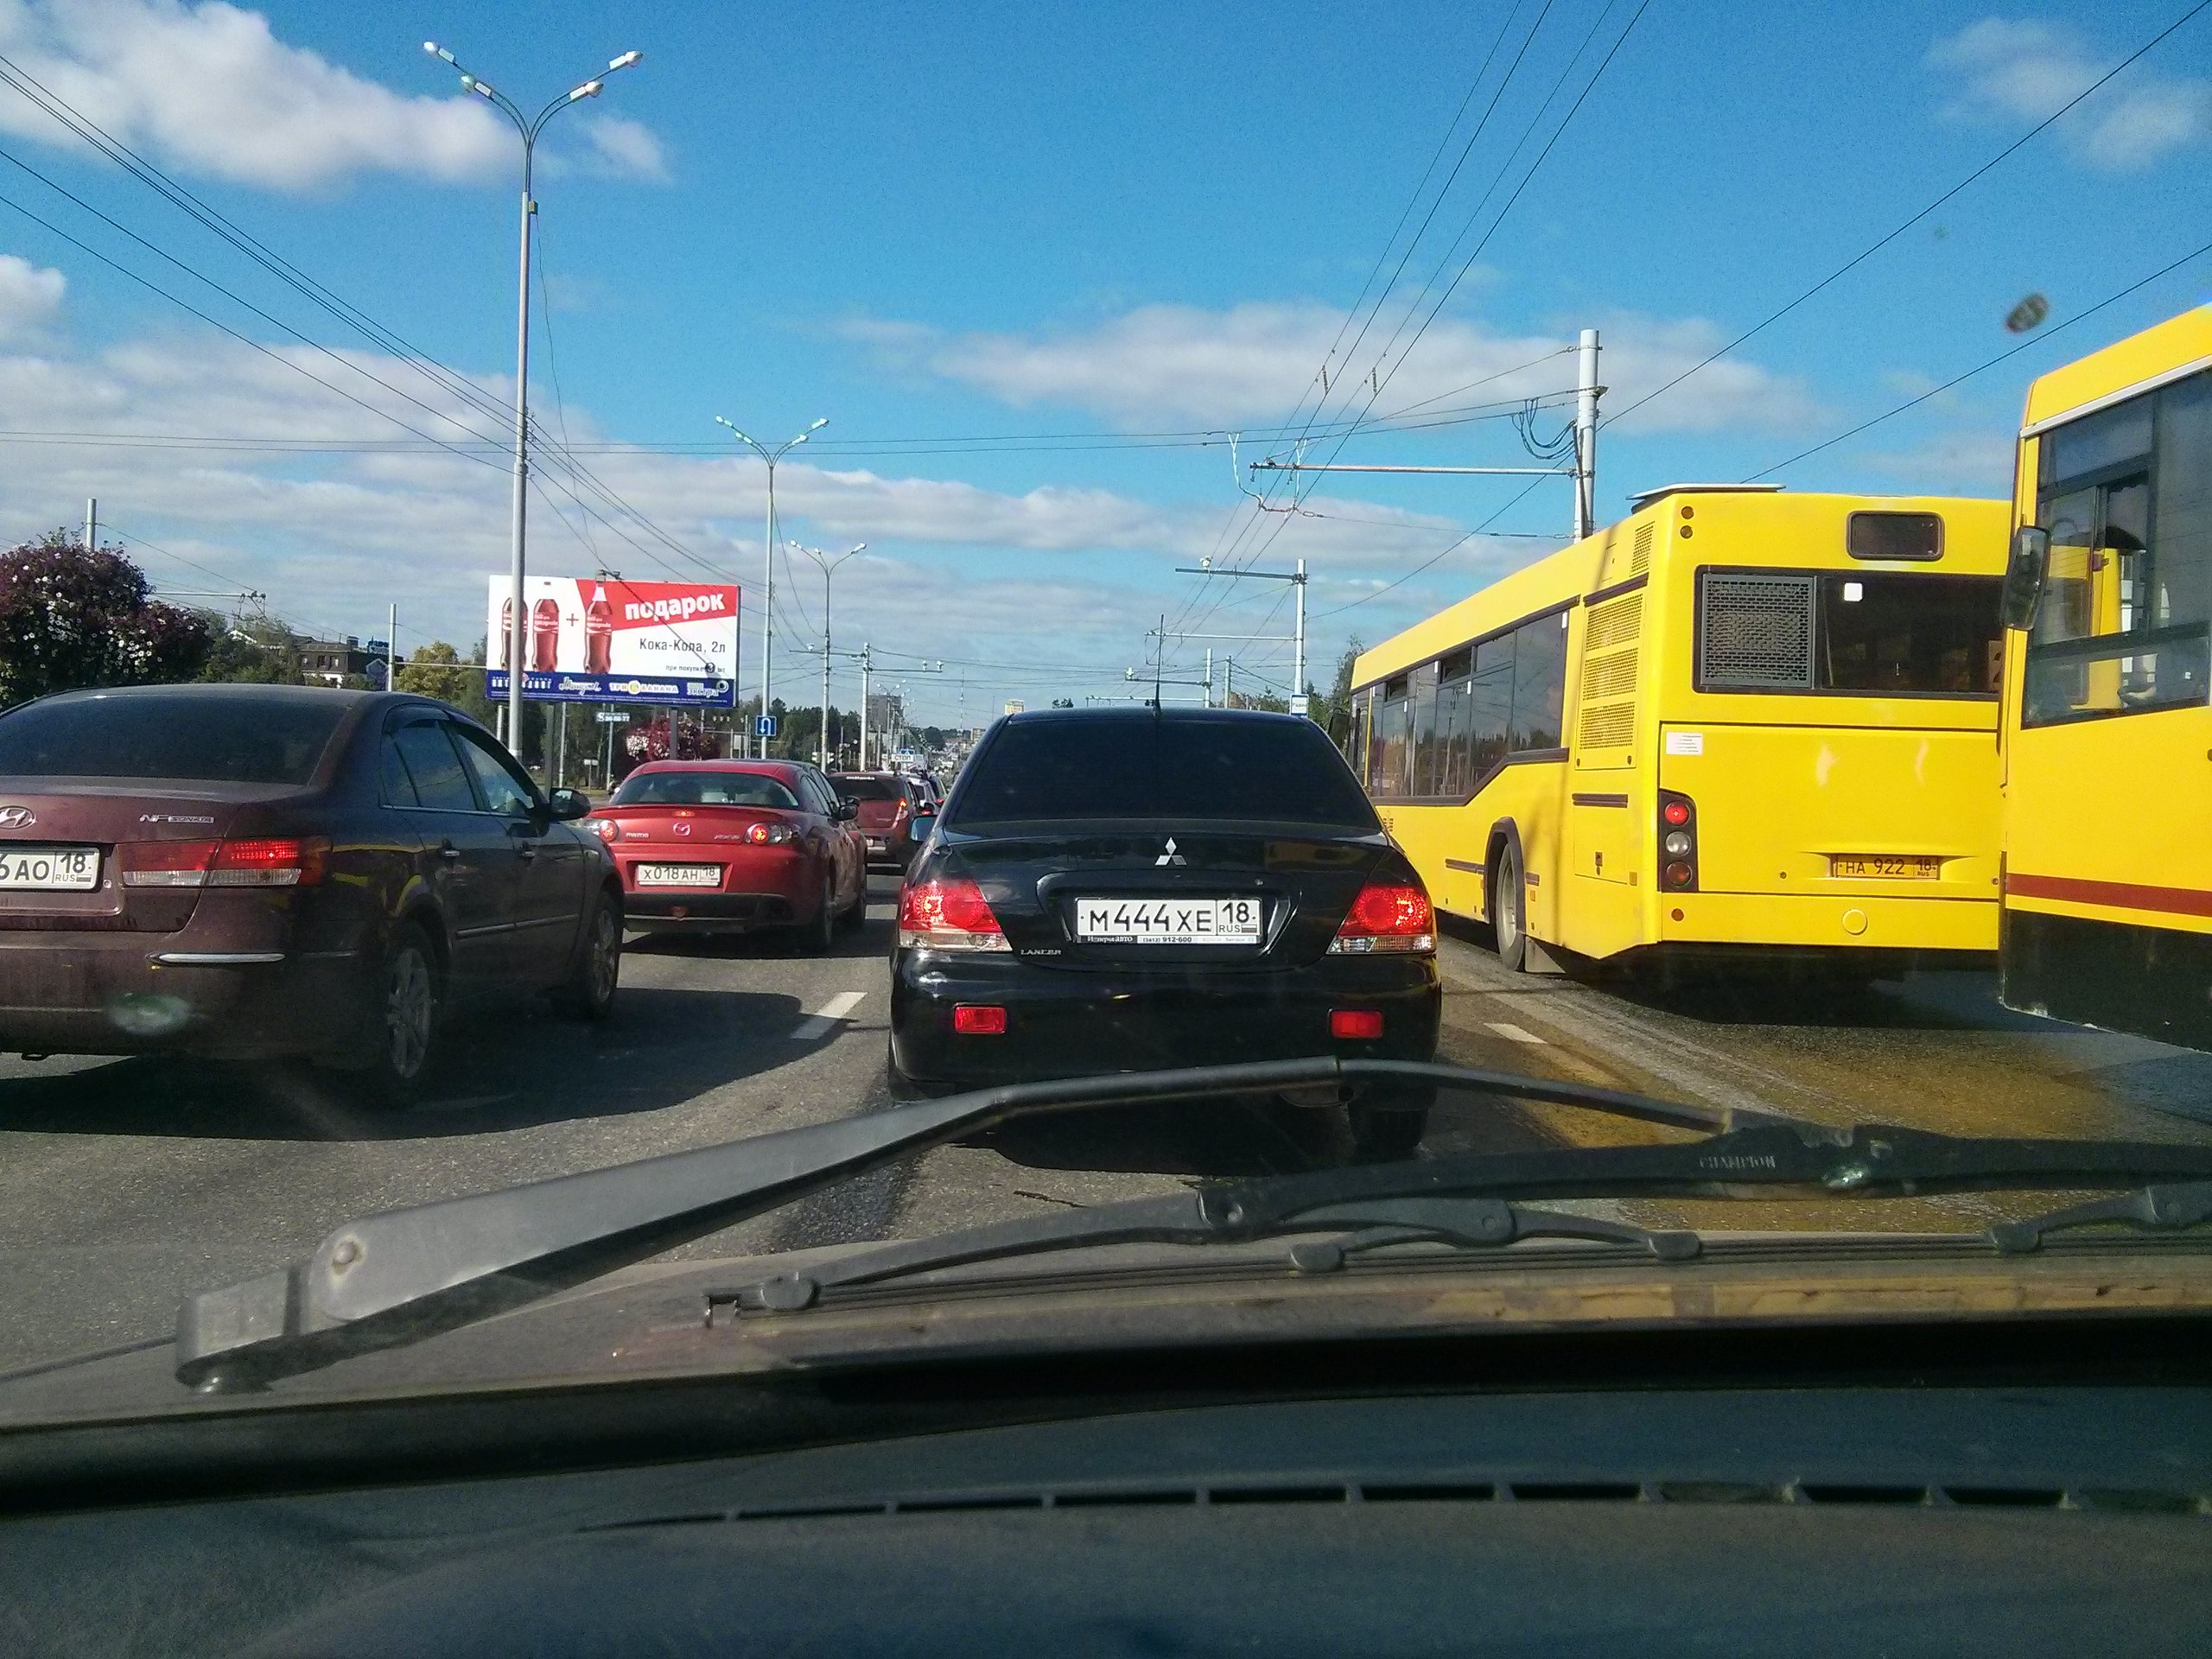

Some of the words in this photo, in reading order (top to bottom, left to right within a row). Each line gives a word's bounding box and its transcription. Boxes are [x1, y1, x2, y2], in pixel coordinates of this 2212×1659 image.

[624, 594, 726, 622] подарок
[711, 641, 726, 653] 2л
[60, 853, 86, 874] 18
[703, 867, 716, 877] 18
[1873, 858, 1905, 875] 922
[1916, 859, 1932, 871] 18
[1221, 902, 1250, 924] 18
[1218, 925, 1241, 933] RUS
